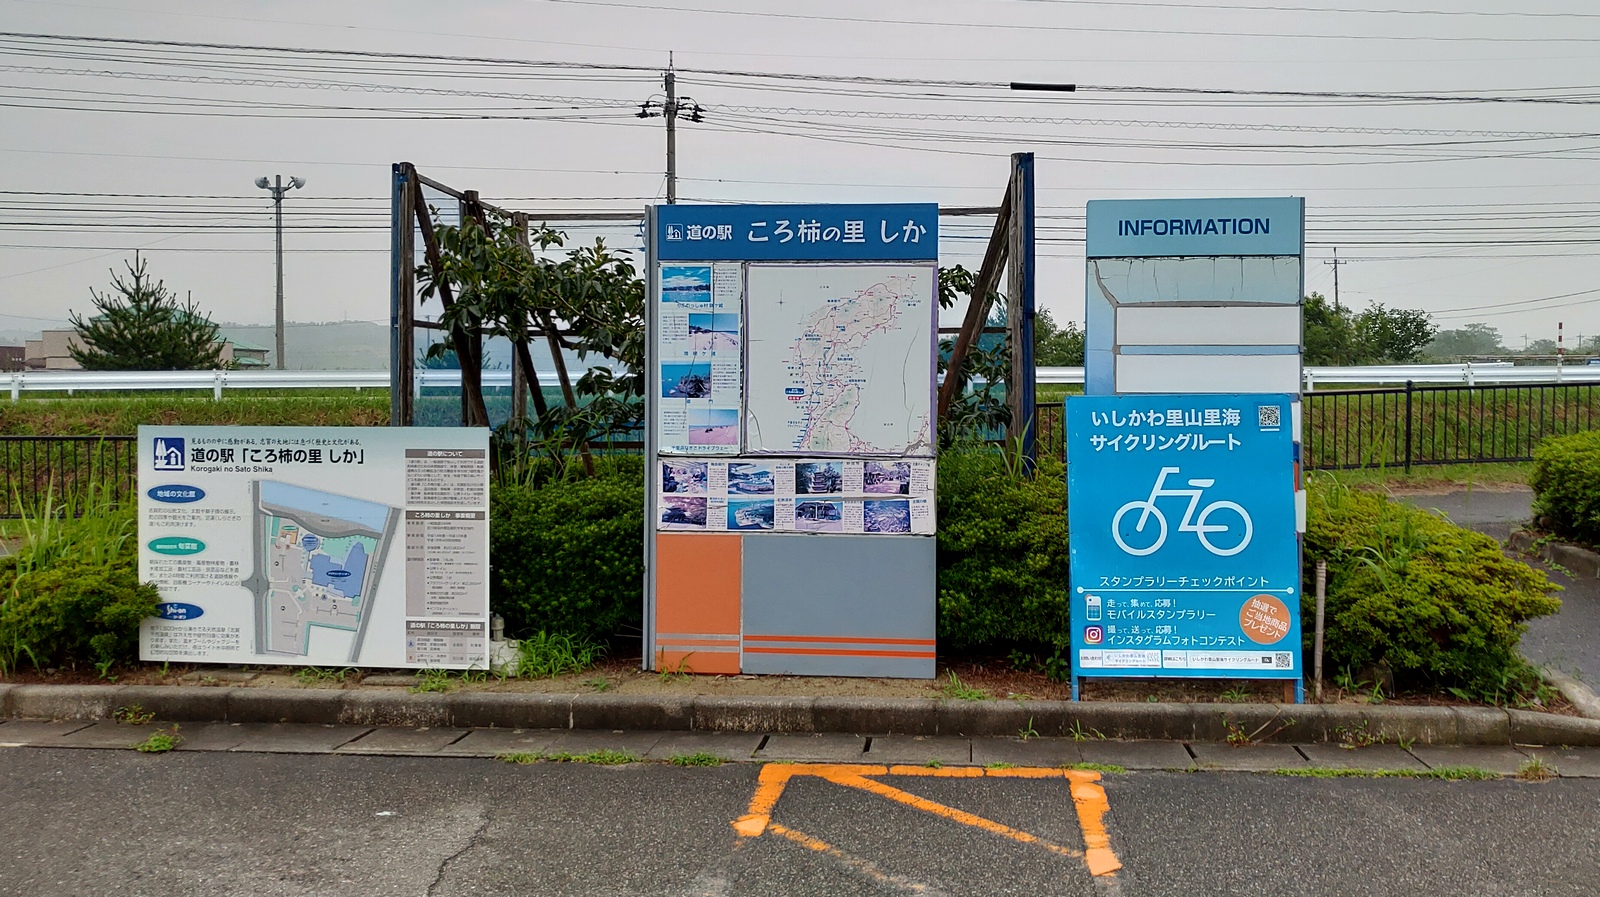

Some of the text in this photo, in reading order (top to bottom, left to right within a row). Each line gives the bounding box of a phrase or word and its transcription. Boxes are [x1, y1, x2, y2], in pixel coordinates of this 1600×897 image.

[686, 219, 927, 243] 道の駅 ころ柿の里 しか
[1118, 218, 1270, 236] INFORMATION
[1091, 408, 1240, 427] いしかわ里山里海
[1090, 433, 1241, 451] サイクリングルート
[190, 465, 222, 473] Korogaki
[1100, 576, 1269, 587] スタンプラリーチェックポイント
[1107, 609, 1216, 620] モバイルスタンプラリー
[1251, 599, 1277, 615] 抽選で
[1244, 618, 1281, 639] プレゼント
[1246, 608, 1288, 632] ご当地商品
[1107, 636, 1245, 646] インスタグラムフォトコンテスト
